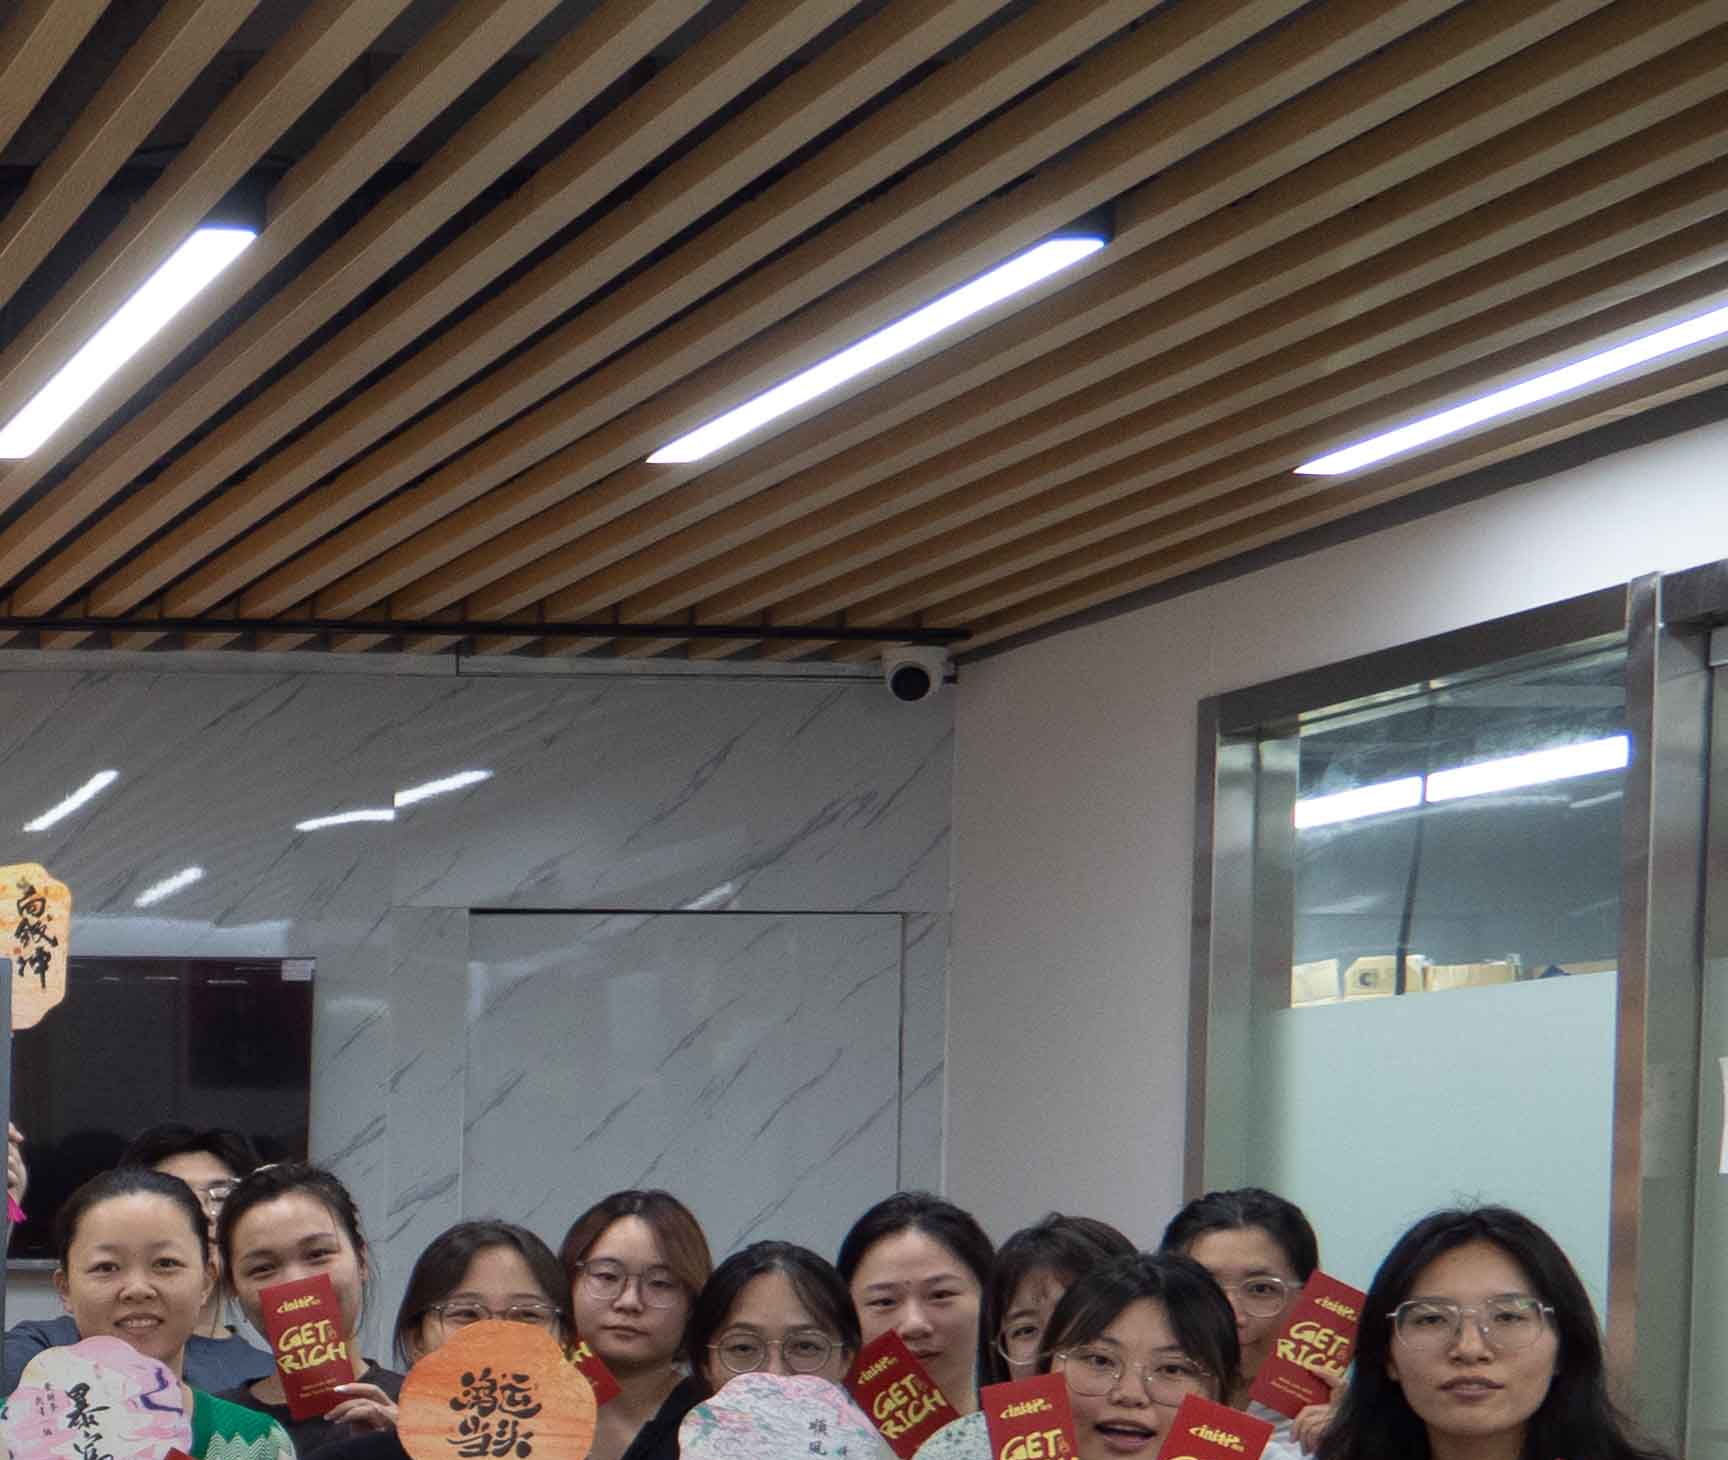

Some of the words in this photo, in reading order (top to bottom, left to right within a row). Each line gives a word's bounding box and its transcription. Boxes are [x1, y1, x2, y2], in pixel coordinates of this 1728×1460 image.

[278, 1318, 330, 1351] GET
[1289, 1321, 1350, 1356] GET
[276, 1340, 347, 1373] RICH
[872, 1372, 918, 1419] GET
[878, 1388, 947, 1439] RICH
